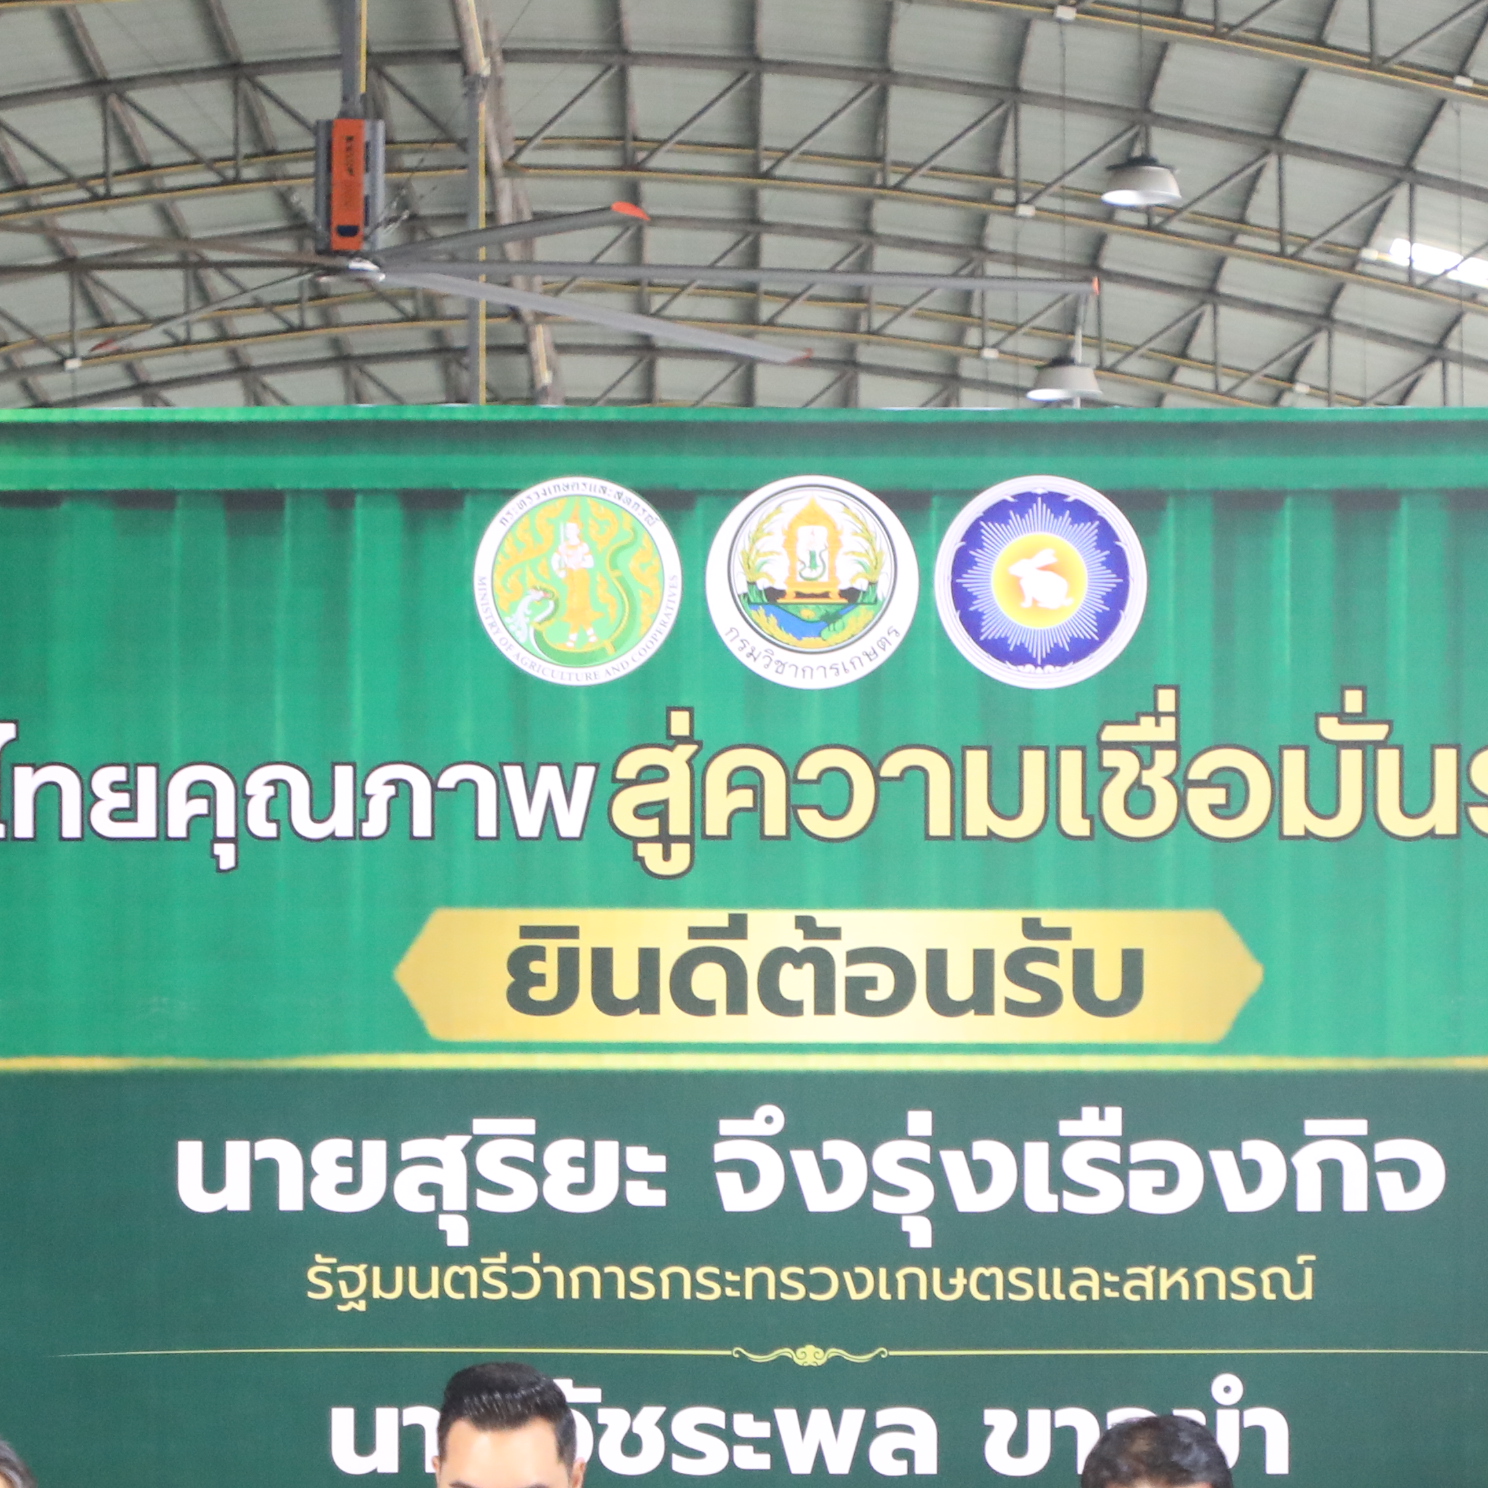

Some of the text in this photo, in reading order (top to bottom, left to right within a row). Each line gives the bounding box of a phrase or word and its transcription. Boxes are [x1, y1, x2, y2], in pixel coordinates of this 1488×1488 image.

[477, 574, 678, 682] MINISTRY OF AGRICULTURE AND COOPERATIVES
[724, 624, 901, 680] กรมวิชาการเกษตร
[506, 910, 1150, 1018] ยินดีต้อนรับ
[176, 1104, 1447, 1250] นายสุริยะ จึงรุ่งเรืองกิจ
[306, 1250, 1318, 1313] รัฐมนตรีว่าการกระทรวงเกษตรและสหกรณ์
